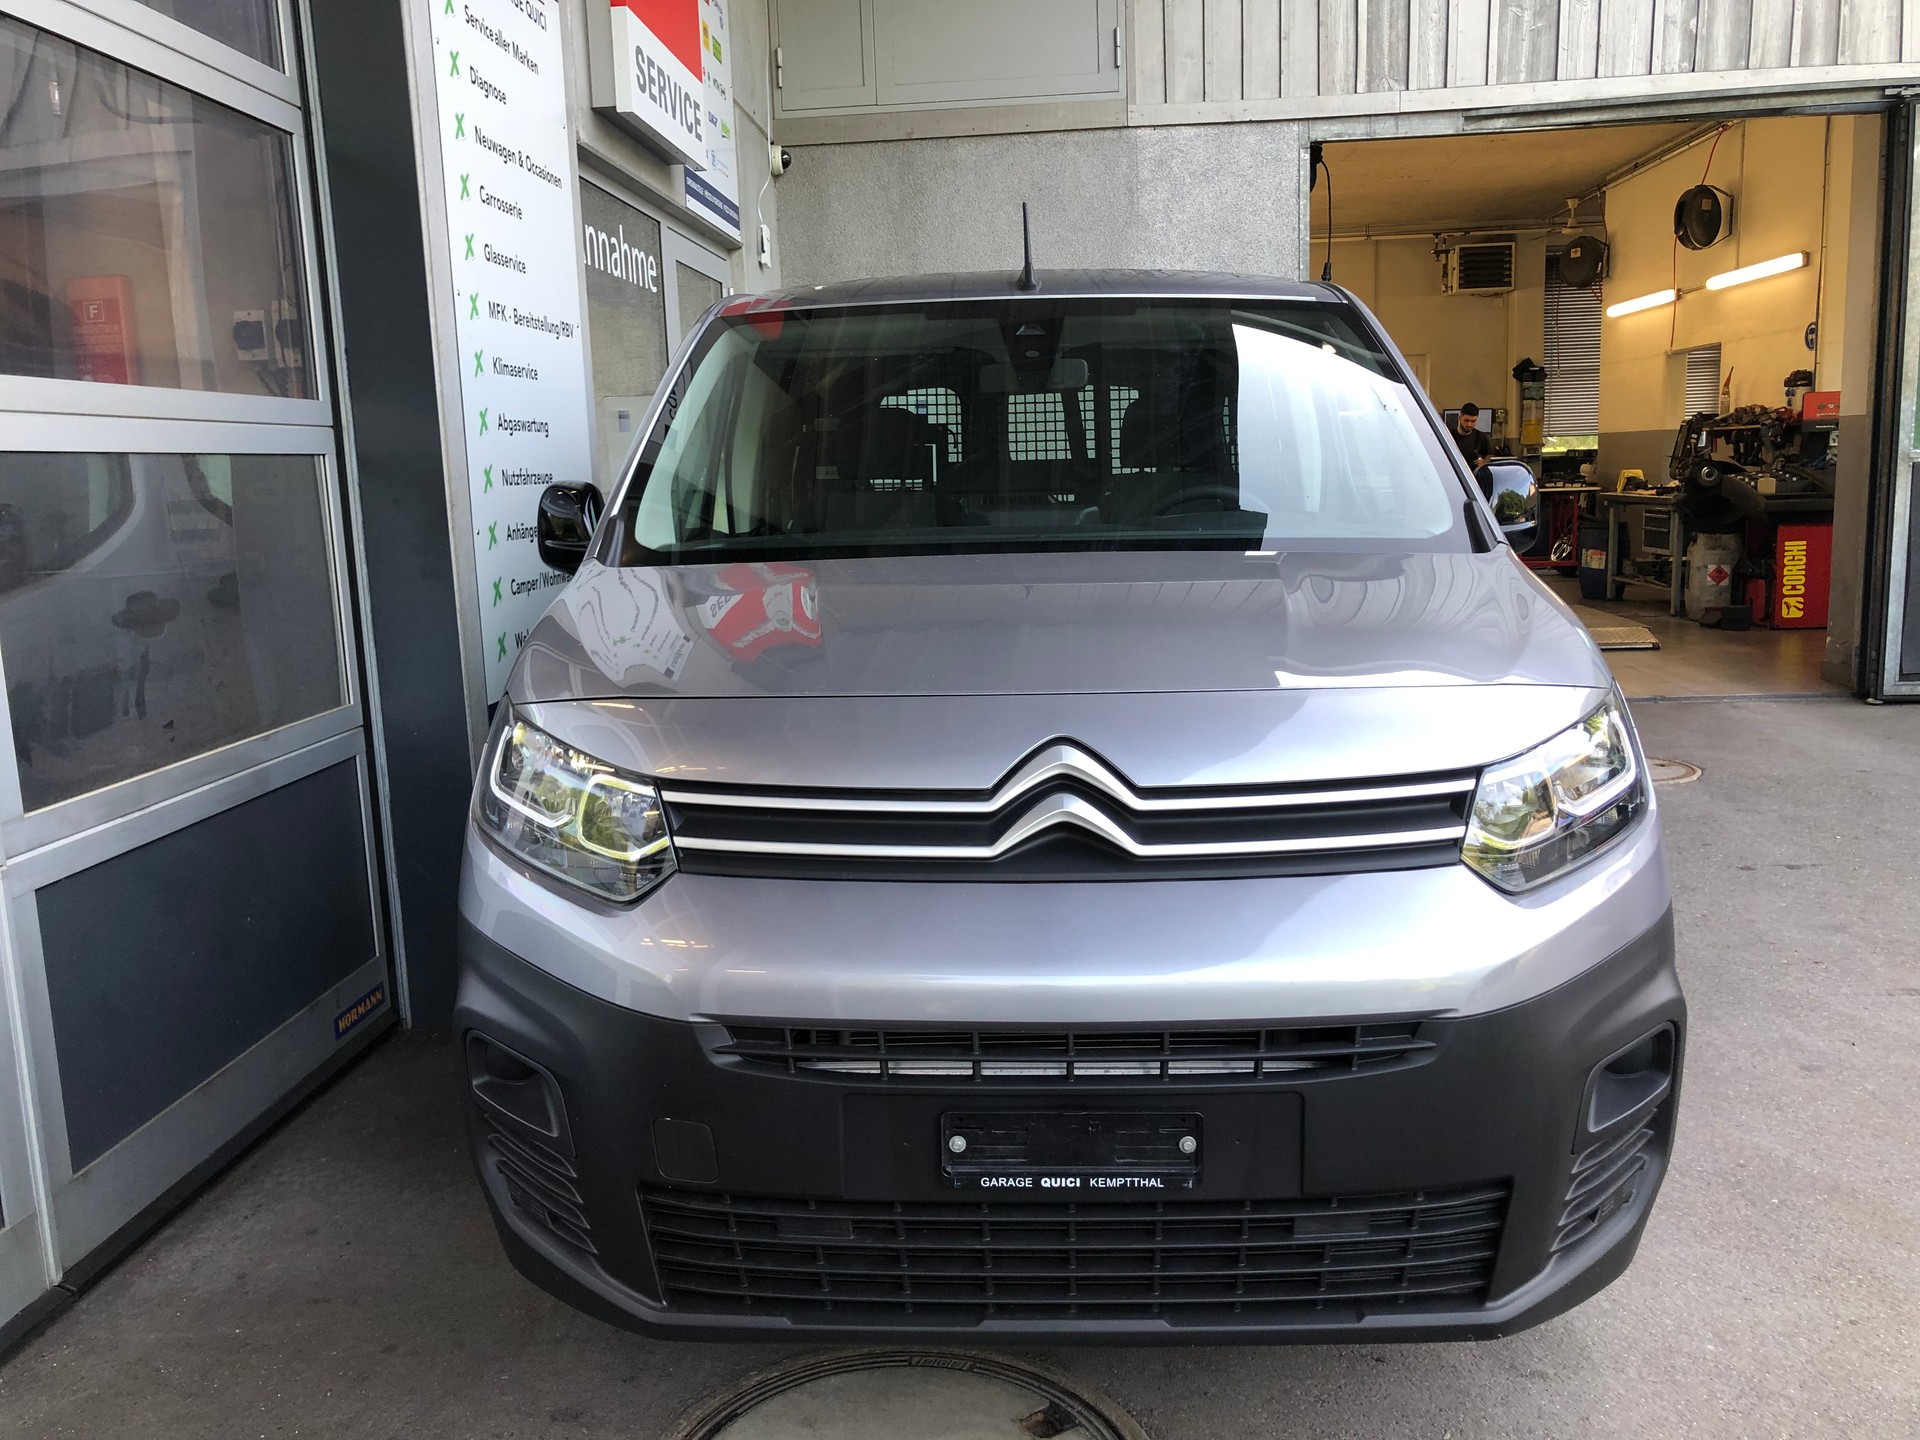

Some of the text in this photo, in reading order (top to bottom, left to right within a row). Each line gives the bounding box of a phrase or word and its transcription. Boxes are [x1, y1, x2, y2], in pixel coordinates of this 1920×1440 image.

[526, 0, 547, 32] QUICI
[464, 4, 539, 75] Service aller Marken
[470, 65, 507, 105] Diagnose
[635, 45, 703, 143] SERVICE
[474, 126, 563, 189] Neuwagen & Occasionen
[479, 185, 523, 220] Carrosserie
[484, 243, 527, 275] Glasservice
[583, 224, 658, 293] nnahme
[89, 305, 98, 318] F
[488, 300, 508, 322] MFK
[492, 357, 539, 381] Klimaservice
[497, 413, 549, 438] Abgaswartung
[501, 468, 553, 487] Nutzfahrzeuge
[506, 523, 538, 543] Anhänge
[1782, 540, 1807, 595] CORGHI
[980, 1177, 1165, 1188] GARAGE QUICI KEMPTTHAL
